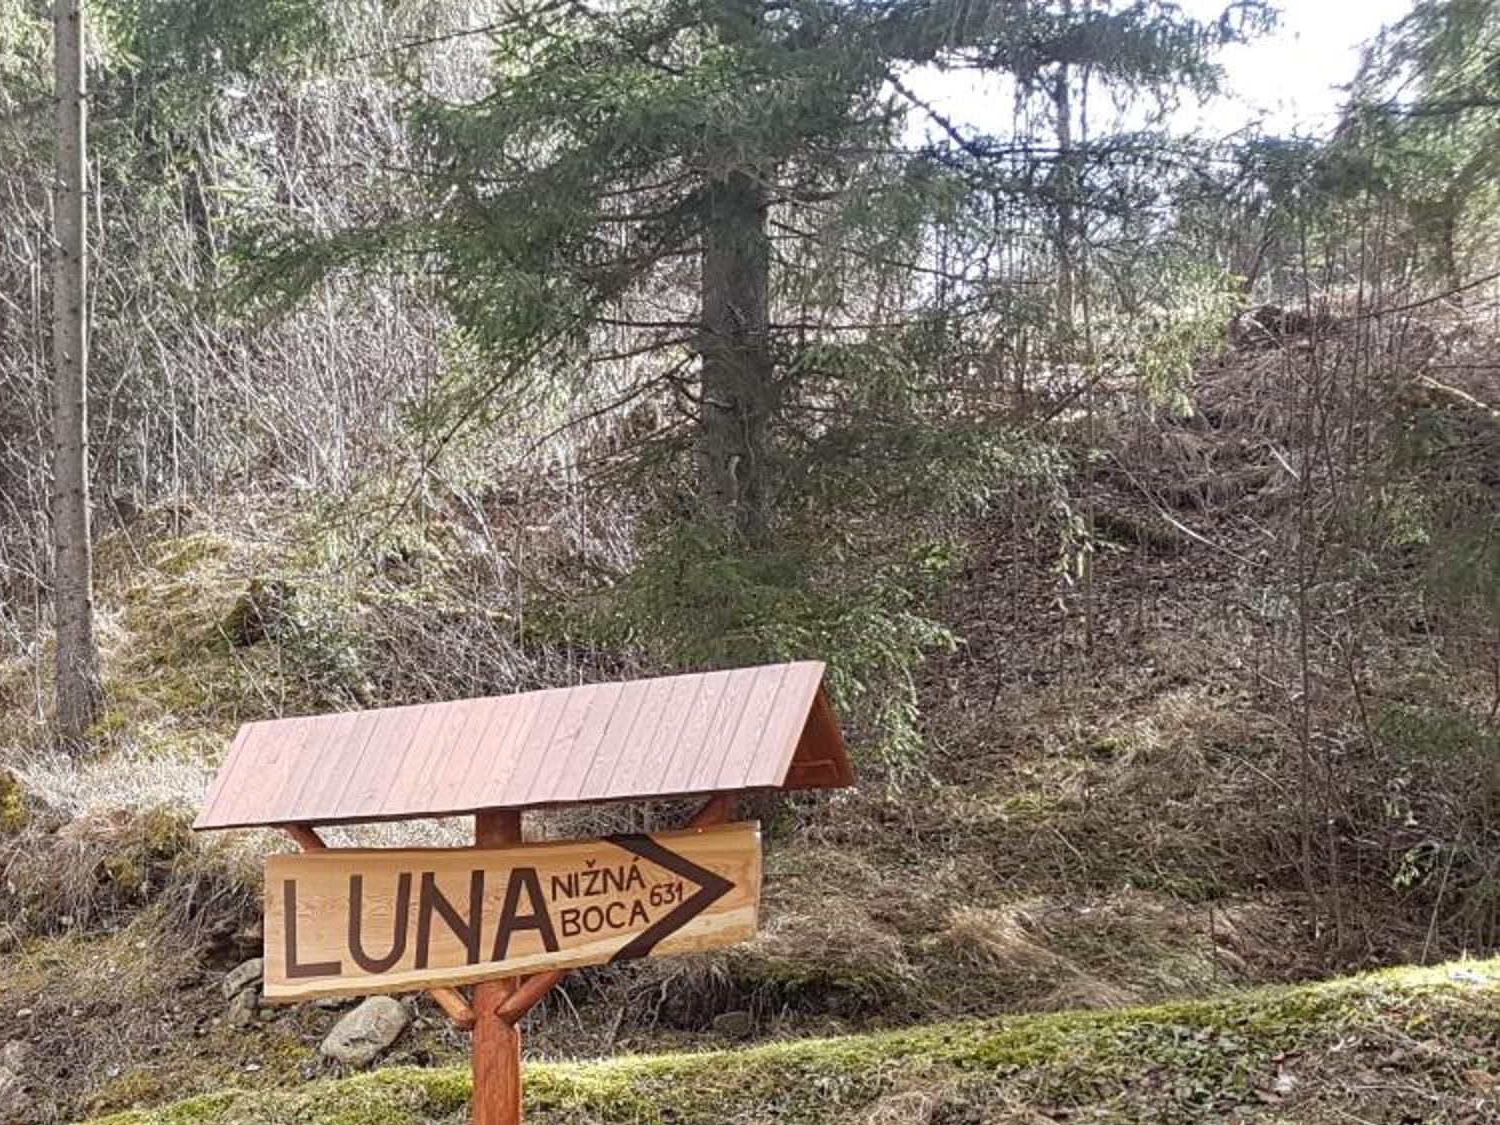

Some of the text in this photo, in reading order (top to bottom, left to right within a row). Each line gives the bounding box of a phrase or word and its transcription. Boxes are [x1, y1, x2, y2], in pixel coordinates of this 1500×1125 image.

[550, 856, 646, 902] NIŽNÁ
[283, 867, 560, 979] LUNA
[560, 881, 684, 937] BOCA 631
